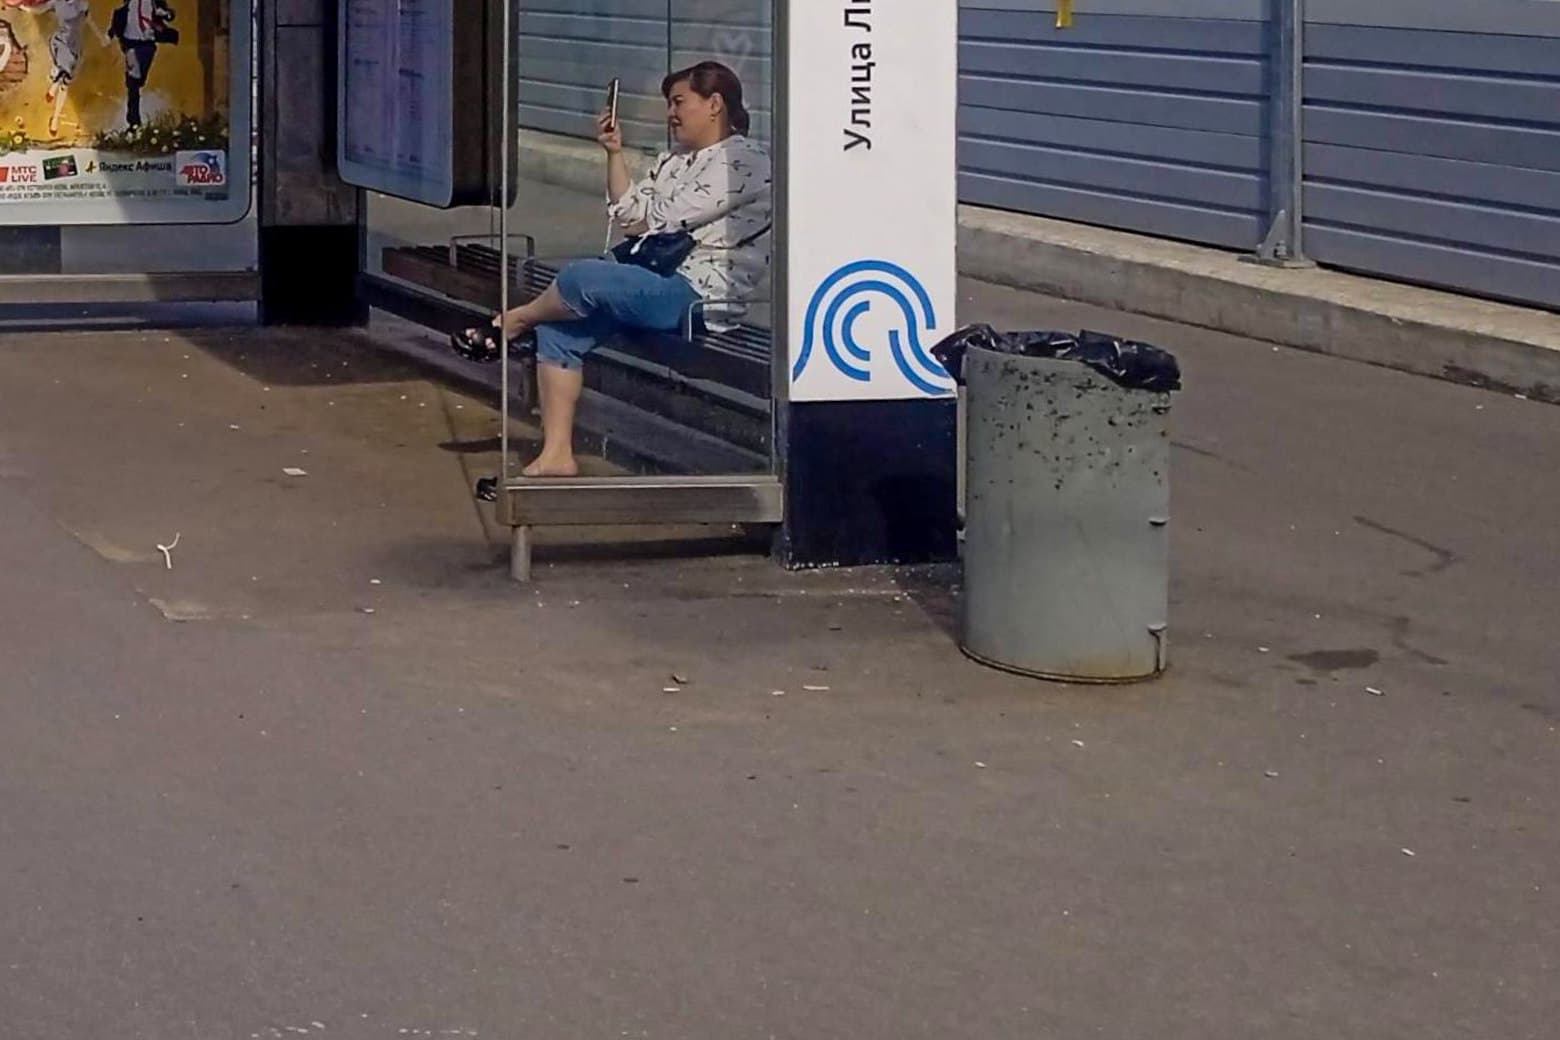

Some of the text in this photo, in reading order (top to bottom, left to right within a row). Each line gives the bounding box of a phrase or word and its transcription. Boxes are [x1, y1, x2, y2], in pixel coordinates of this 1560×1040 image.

[843, 45, 877, 151] Улица
[11, 165, 37, 174] МТС
[99, 161, 172, 172] Яндекс Афиша
[11, 174, 37, 183] LIVE
